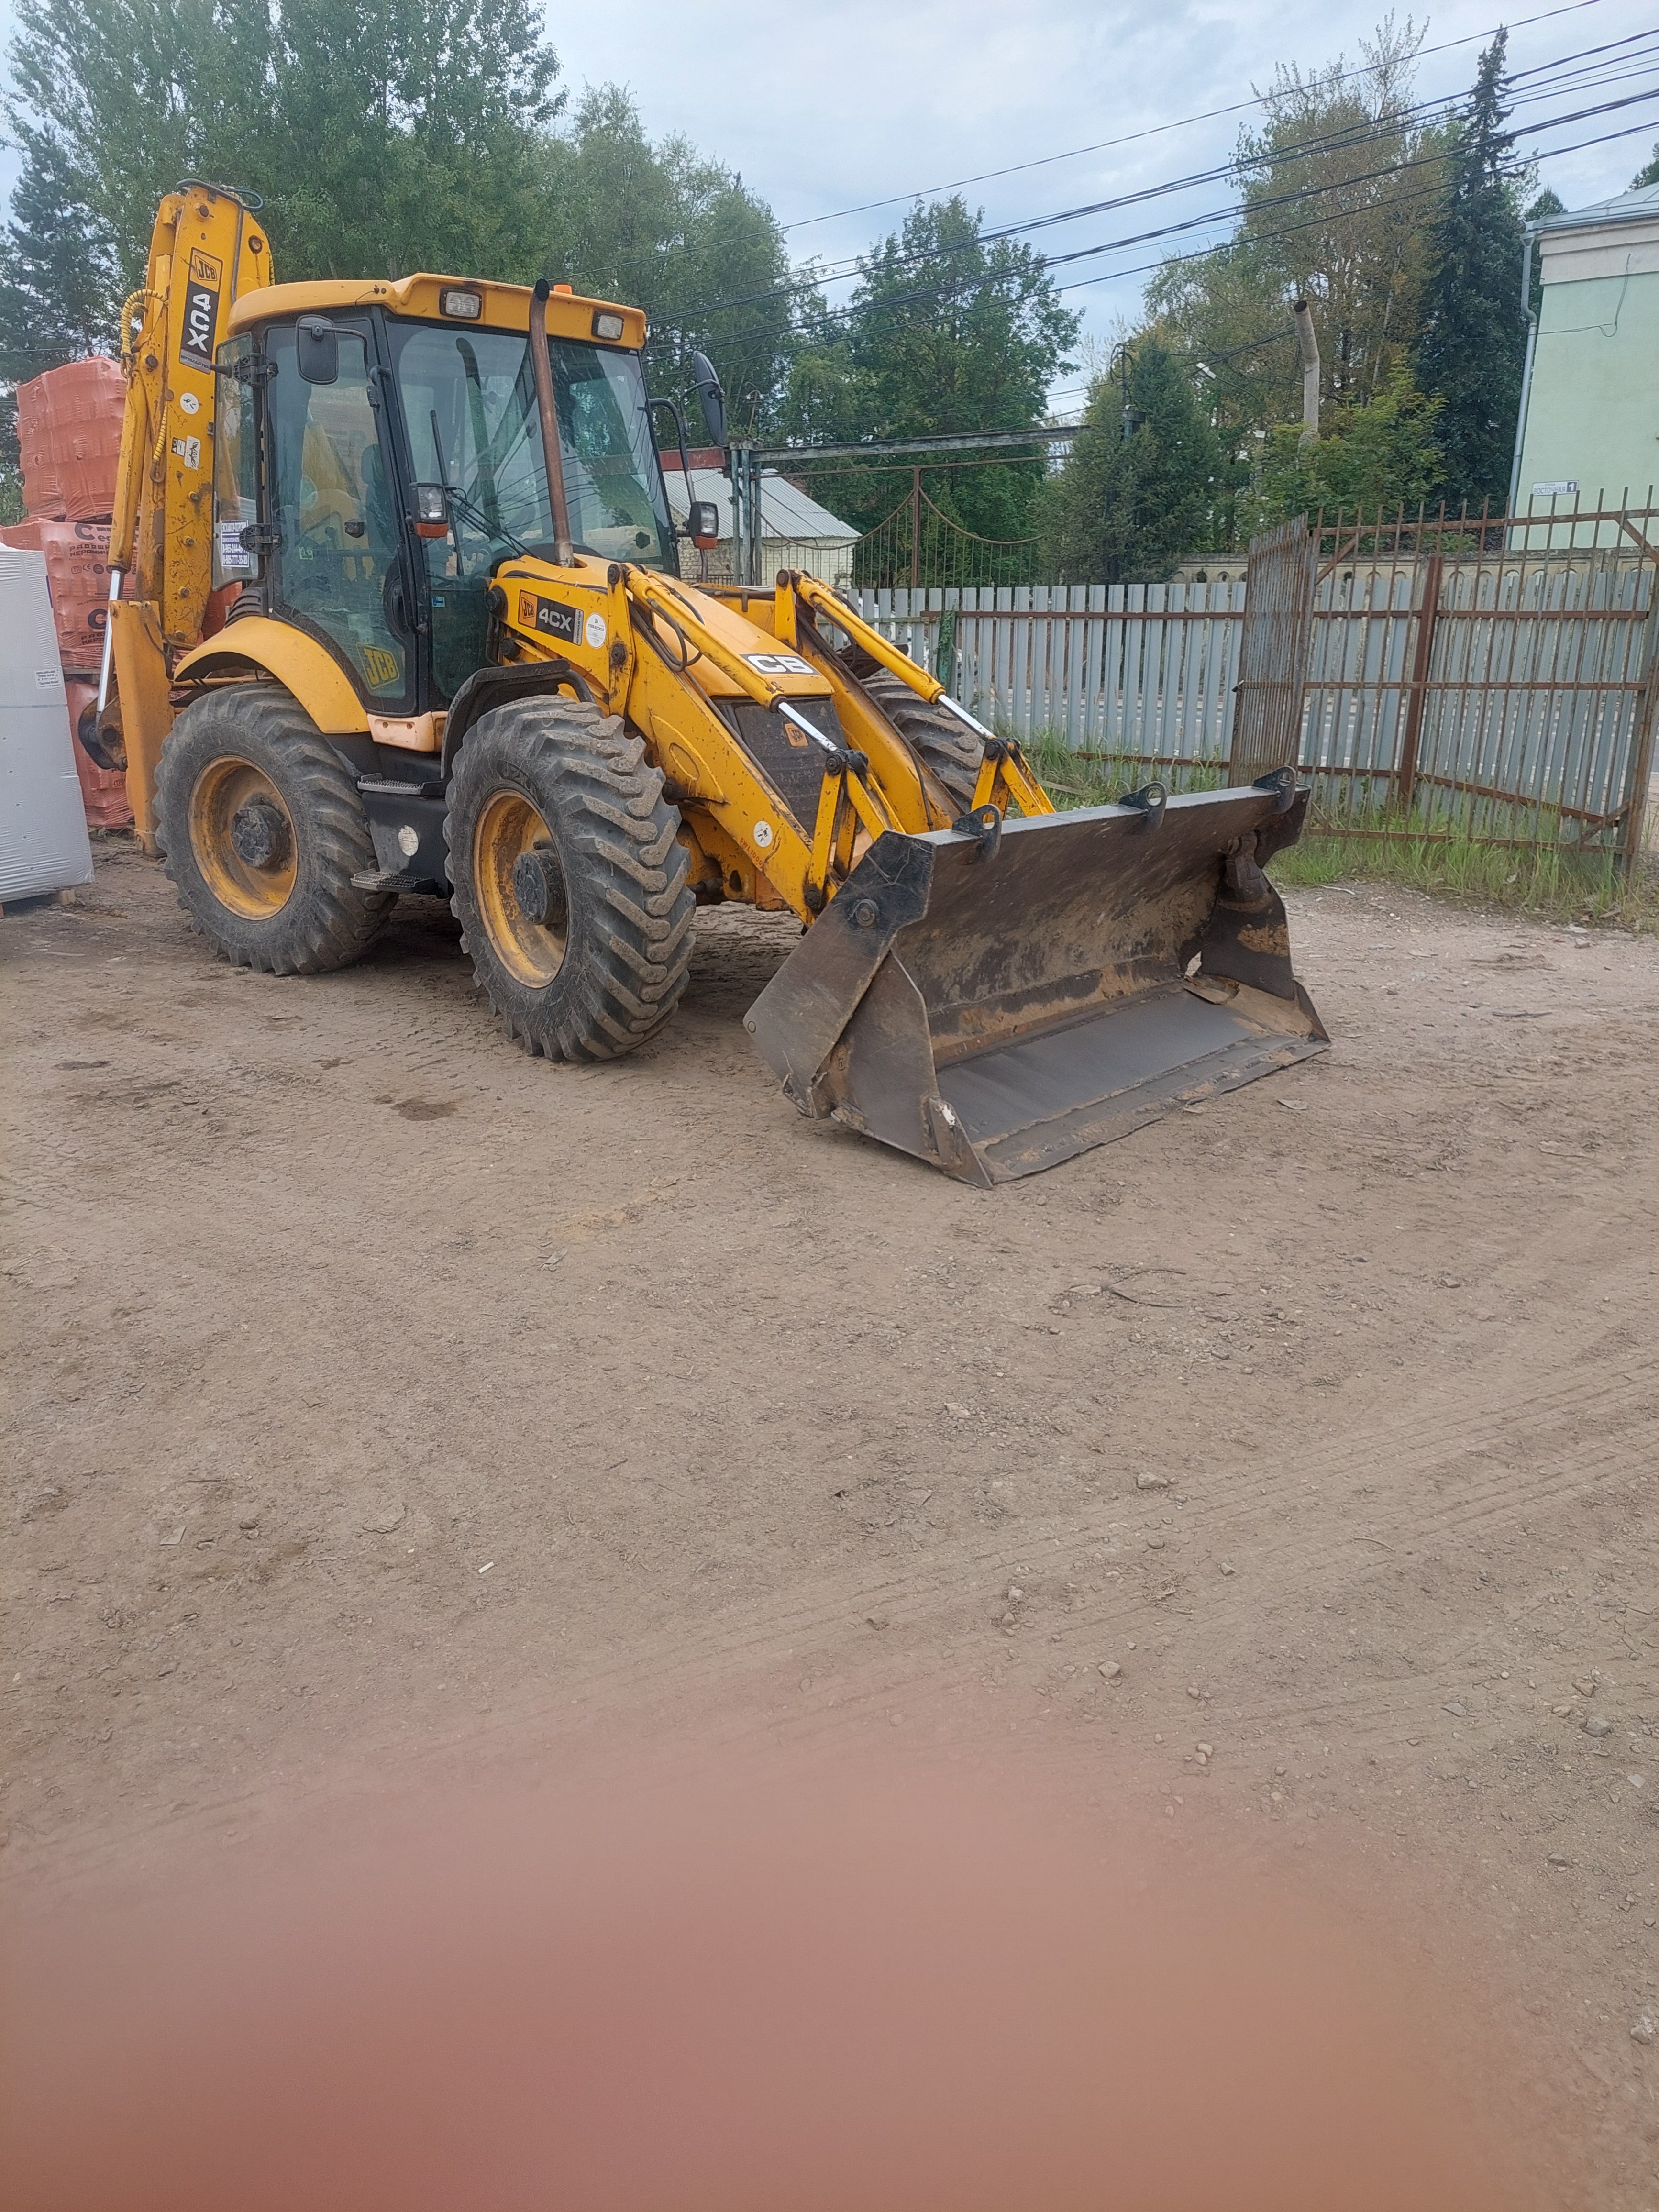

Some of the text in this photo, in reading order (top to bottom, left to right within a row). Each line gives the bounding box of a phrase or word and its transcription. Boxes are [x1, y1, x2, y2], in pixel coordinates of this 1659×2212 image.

[198, 259, 216, 280] JCB
[186, 293, 211, 353] 4CX
[1533, 486, 1566, 495] ВОСТОЧНАЯ
[1568, 482, 1575, 492] 1
[523, 600, 573, 632] JCB 4CX
[364, 648, 397, 685] JCB
